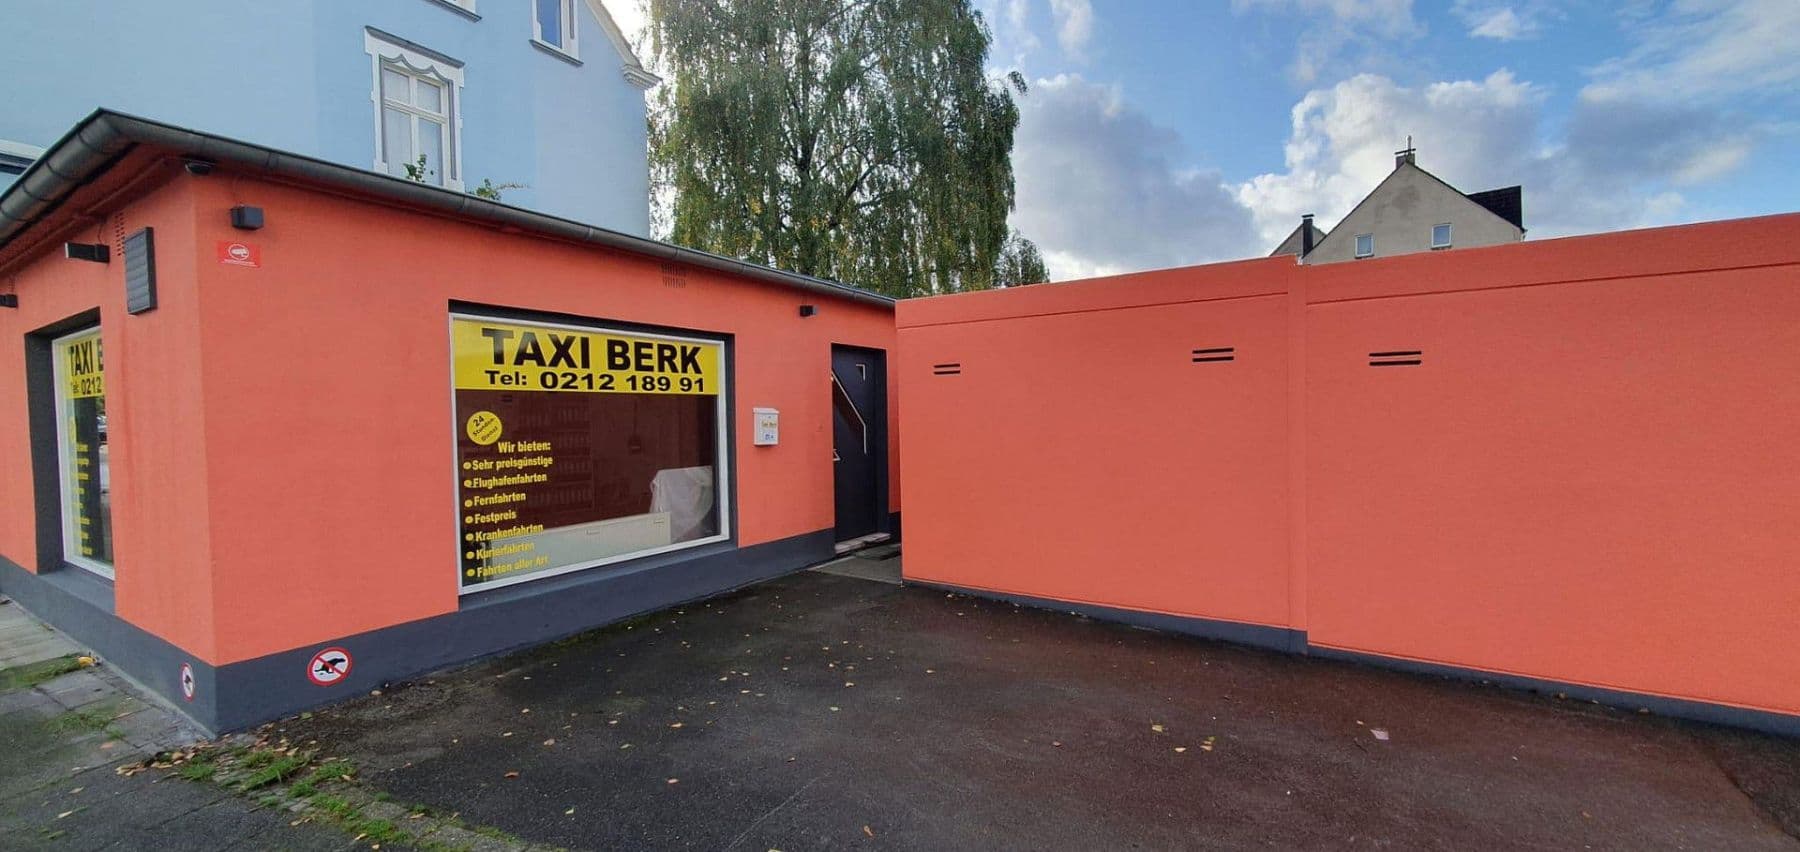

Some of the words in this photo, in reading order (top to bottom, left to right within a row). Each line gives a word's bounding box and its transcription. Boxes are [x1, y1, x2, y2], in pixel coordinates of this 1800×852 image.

[482, 328, 590, 369] TAXI
[607, 339, 702, 374] BERK
[486, 371, 527, 385] Tel:
[540, 372, 615, 390] 0212
[625, 376, 671, 391] 189
[679, 378, 704, 392] 91
[473, 415, 484, 427] 24
[498, 441, 516, 453] Wir
[517, 441, 551, 452] bieten:
[472, 459, 494, 470] Sehr
[496, 456, 553, 471] preisgünstige
[473, 473, 547, 489] Flughafenfahrten
[474, 492, 526, 506] Fernfahrten
[474, 509, 517, 524] Festpreis
[475, 524, 544, 542] Krankenfahrten
[477, 563, 512, 577] Fahrten
